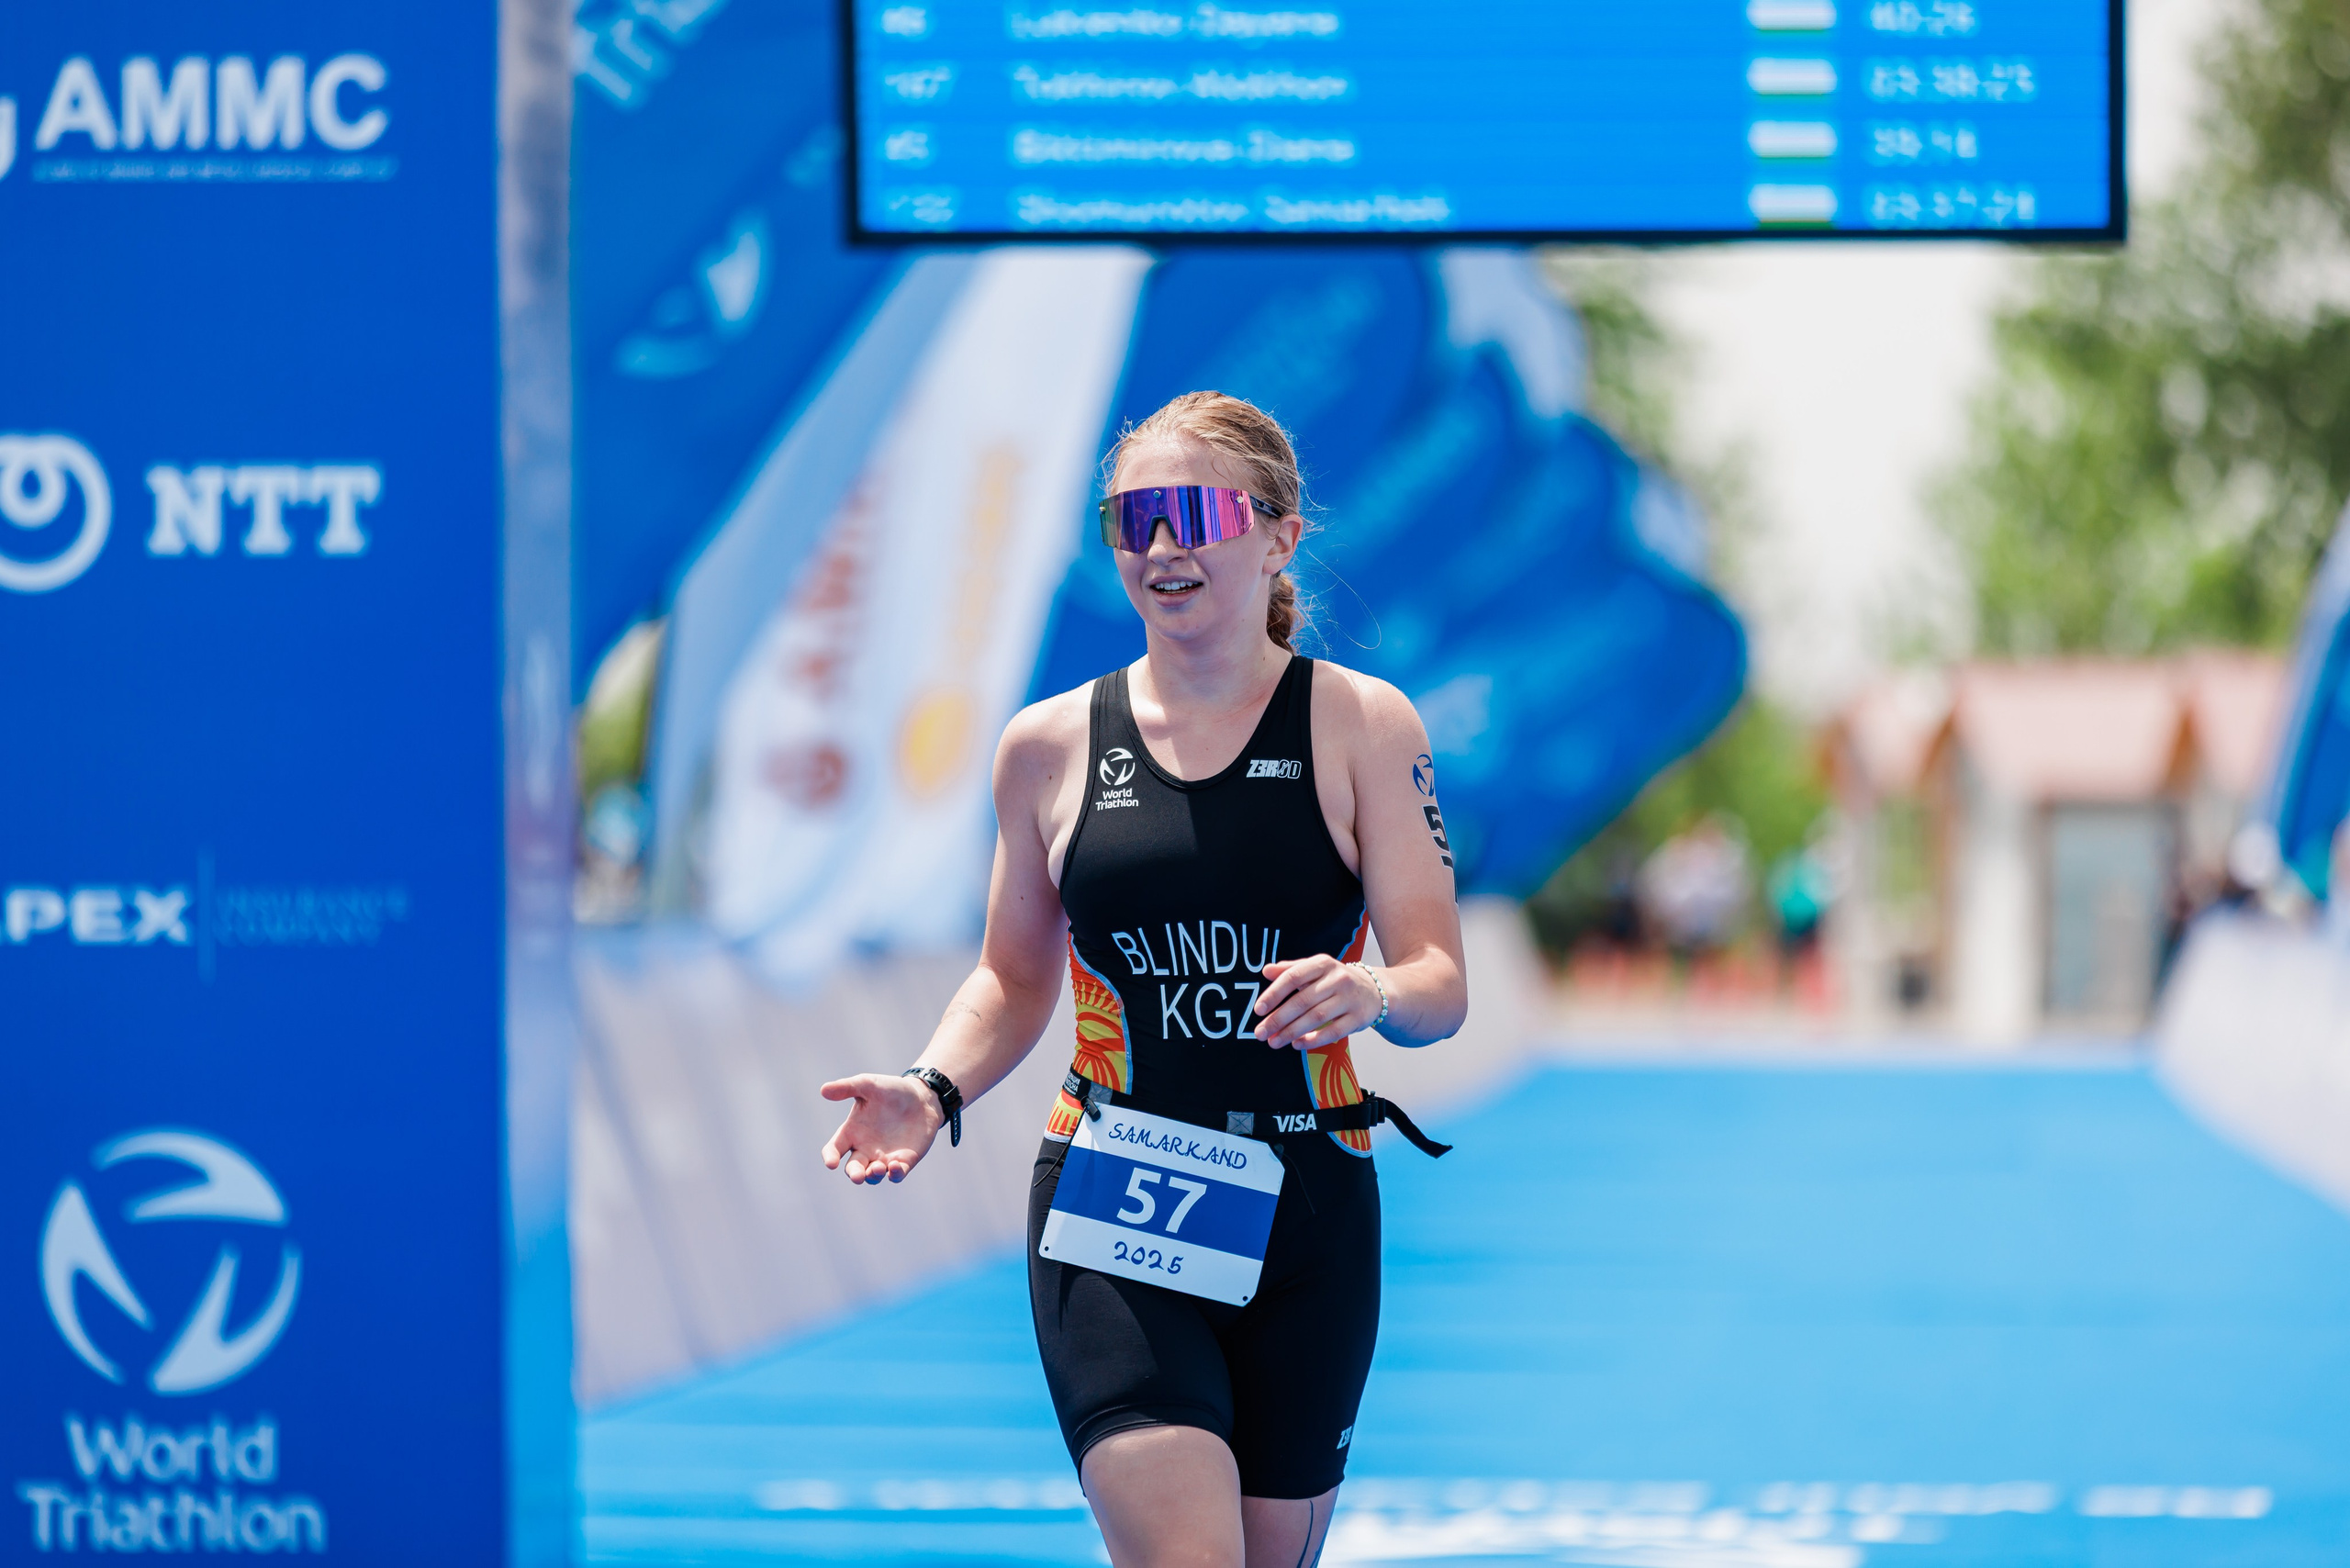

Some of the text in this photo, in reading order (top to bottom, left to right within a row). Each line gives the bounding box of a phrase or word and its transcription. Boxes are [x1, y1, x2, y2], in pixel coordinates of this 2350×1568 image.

[34, 52, 390, 151] AMMC
[147, 465, 381, 555] NTT
[1095, 798, 1139, 812] Triathlon
[1102, 788, 1133, 801] World
[0, 887, 188, 945] PEX
[1160, 982, 1260, 1040] KGZ
[1108, 1123, 1248, 1170] SAMARKAND
[1272, 1112, 1317, 1133] VISA
[1116, 1167, 1208, 1234] 57
[1113, 1241, 1184, 1275] 2025
[64, 1413, 281, 1484] World
[18, 1482, 329, 1553] Triathlon
